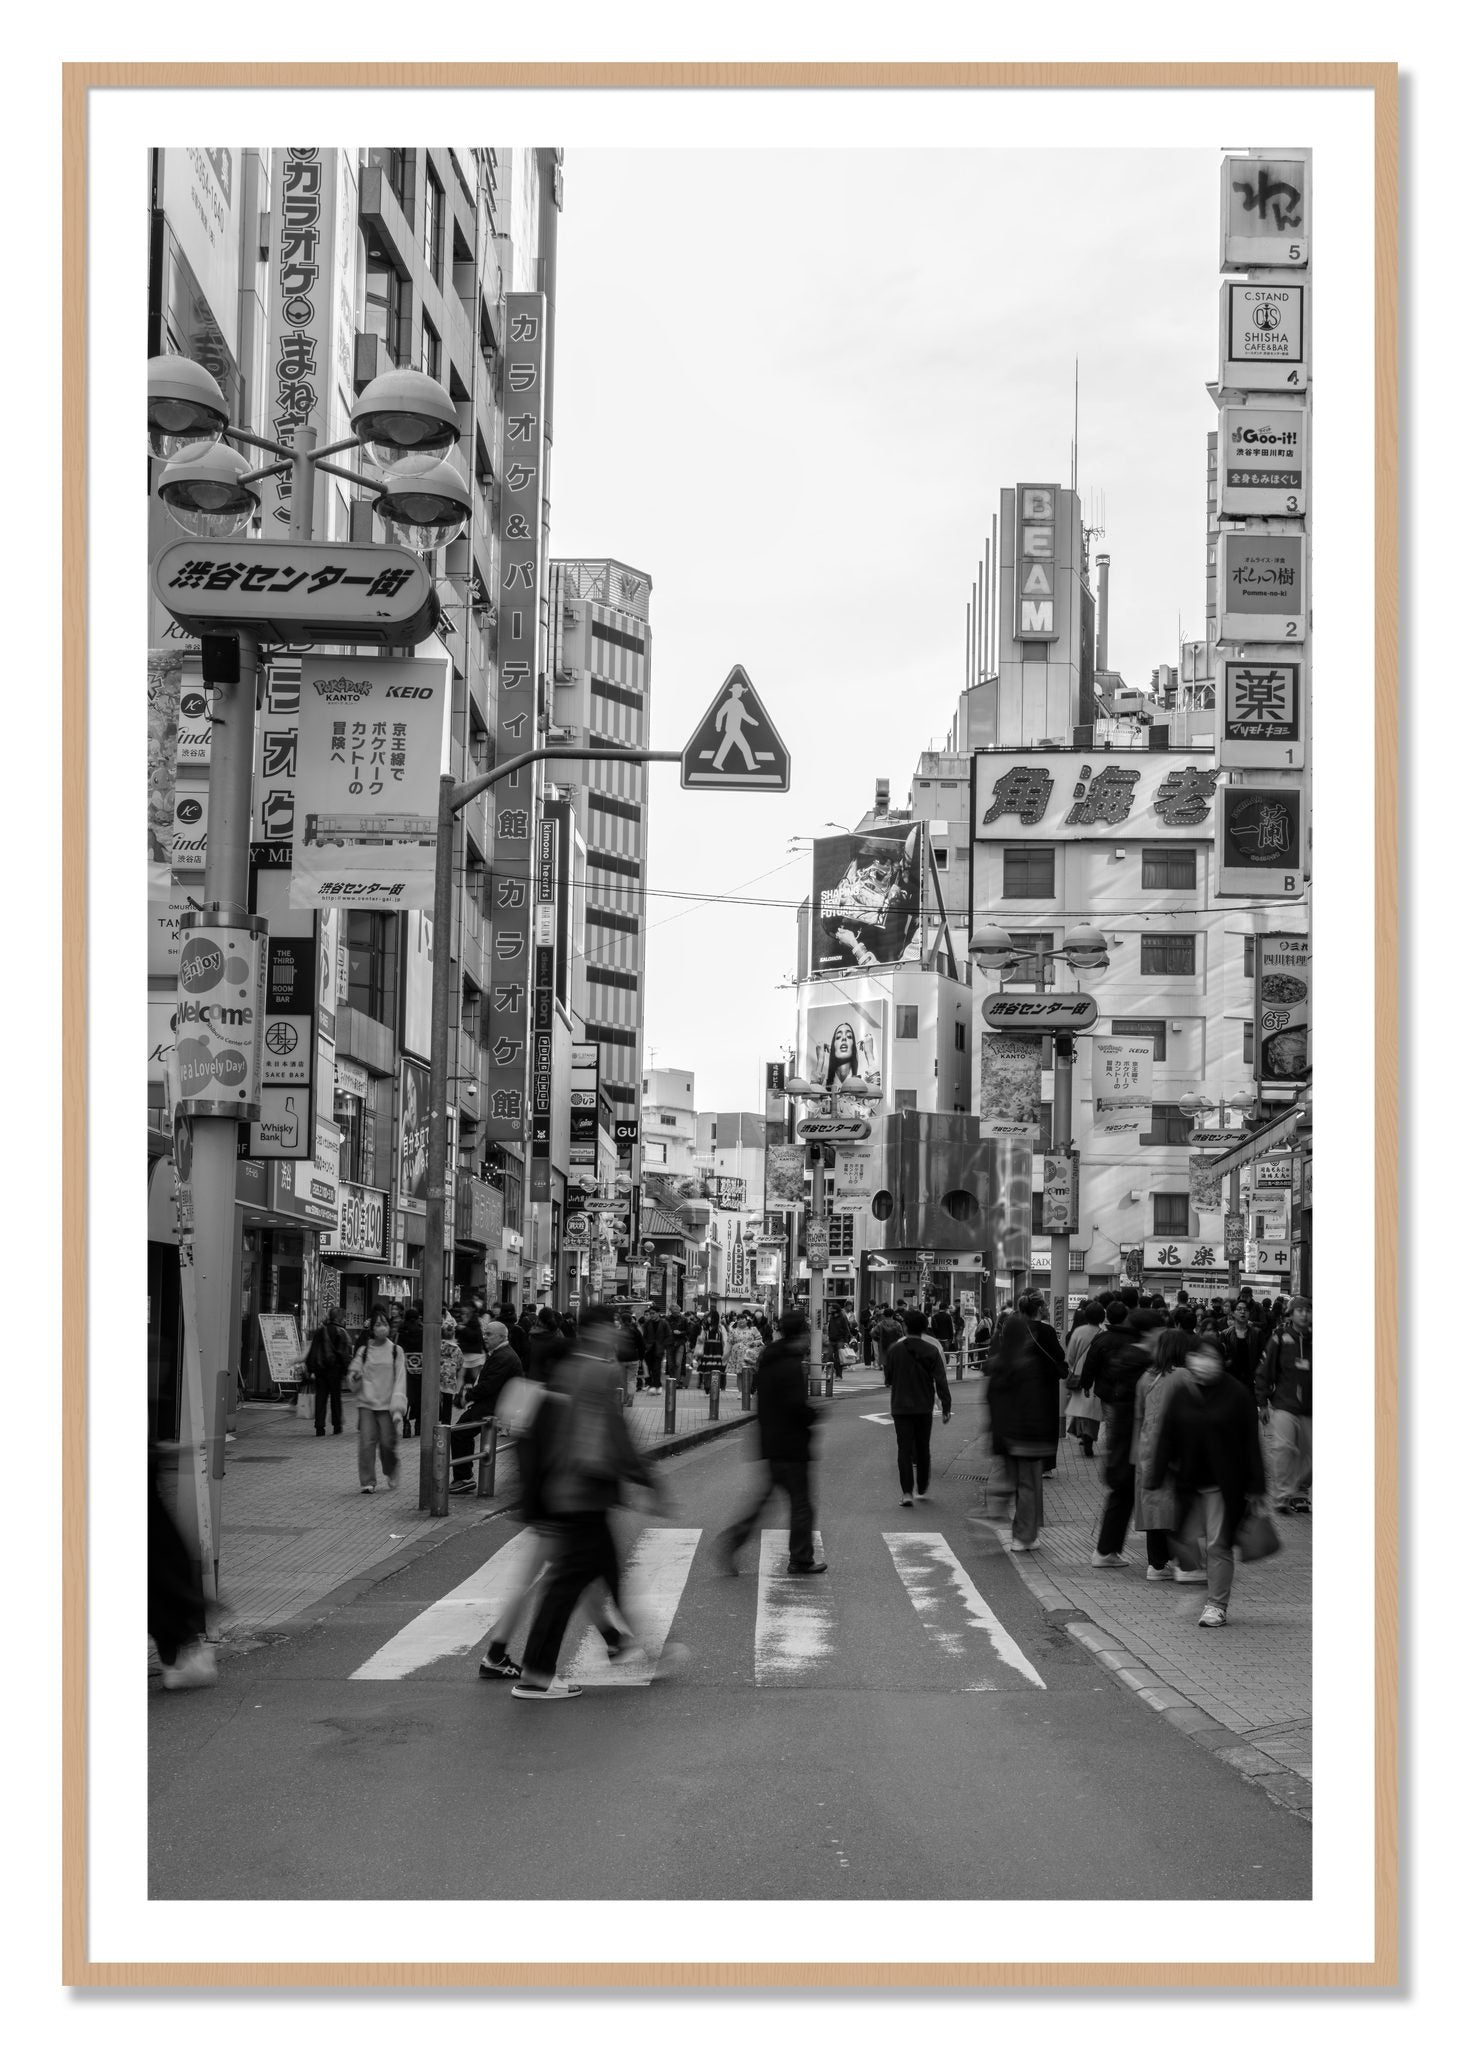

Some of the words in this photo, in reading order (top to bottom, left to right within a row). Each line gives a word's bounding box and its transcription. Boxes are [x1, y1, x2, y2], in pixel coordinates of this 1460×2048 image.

[280, 161, 321, 298] カラオケ
[1289, 245, 1300, 260] 5
[1245, 292, 1289, 301] C.STAND
[1245, 332, 1288, 342] SHISHA
[1245, 343, 1288, 351] CAFE&BAR
[1287, 370, 1299, 385] 4
[1243, 429, 1297, 444] Goo-it!
[1236, 448, 1294, 457] 渋谷宇田川町店
[1231, 473, 1298, 485] 全身もみほぐし
[1286, 496, 1298, 512] 3
[1021, 488, 1053, 632] BEAM
[168, 560, 415, 597] 渋谷センター街
[1286, 622, 1297, 637] 2
[385, 686, 434, 699] KEIO
[1235, 670, 1285, 720] 薬
[1229, 723, 1291, 737] マツモトキヨシ
[330, 721, 346, 764] 冒険へ
[182, 749, 206, 757] 渋谷店
[349, 721, 366, 795] カントーの
[369, 721, 386, 795] ポケパーク
[390, 722, 407, 781] 京王線で
[1285, 748, 1293, 764] 1
[983, 765, 1221, 825] 角海老
[1230, 803, 1290, 852] 一蘭
[177, 855, 202, 863] 渋谷店
[318, 882, 406, 895] 渋谷センター街
[1284, 876, 1296, 891] B
[182, 951, 221, 985] Enjoy
[1263, 954, 1307, 967] 四川料理
[989, 1002, 1092, 1015] 渋谷センター街
[1262, 1011, 1291, 1031] 6F
[194, 1057, 224, 1077] Lovely
[226, 1059, 246, 1073] Day!
[1113, 1060, 1121, 1089] カントーの
[261, 1123, 294, 1134] Whisky
[617, 1127, 637, 1137] GU
[801, 1124, 862, 1133] 渋谷センター街
[260, 1133, 280, 1141] Bank
[1157, 1244, 1216, 1266] 兆楽
